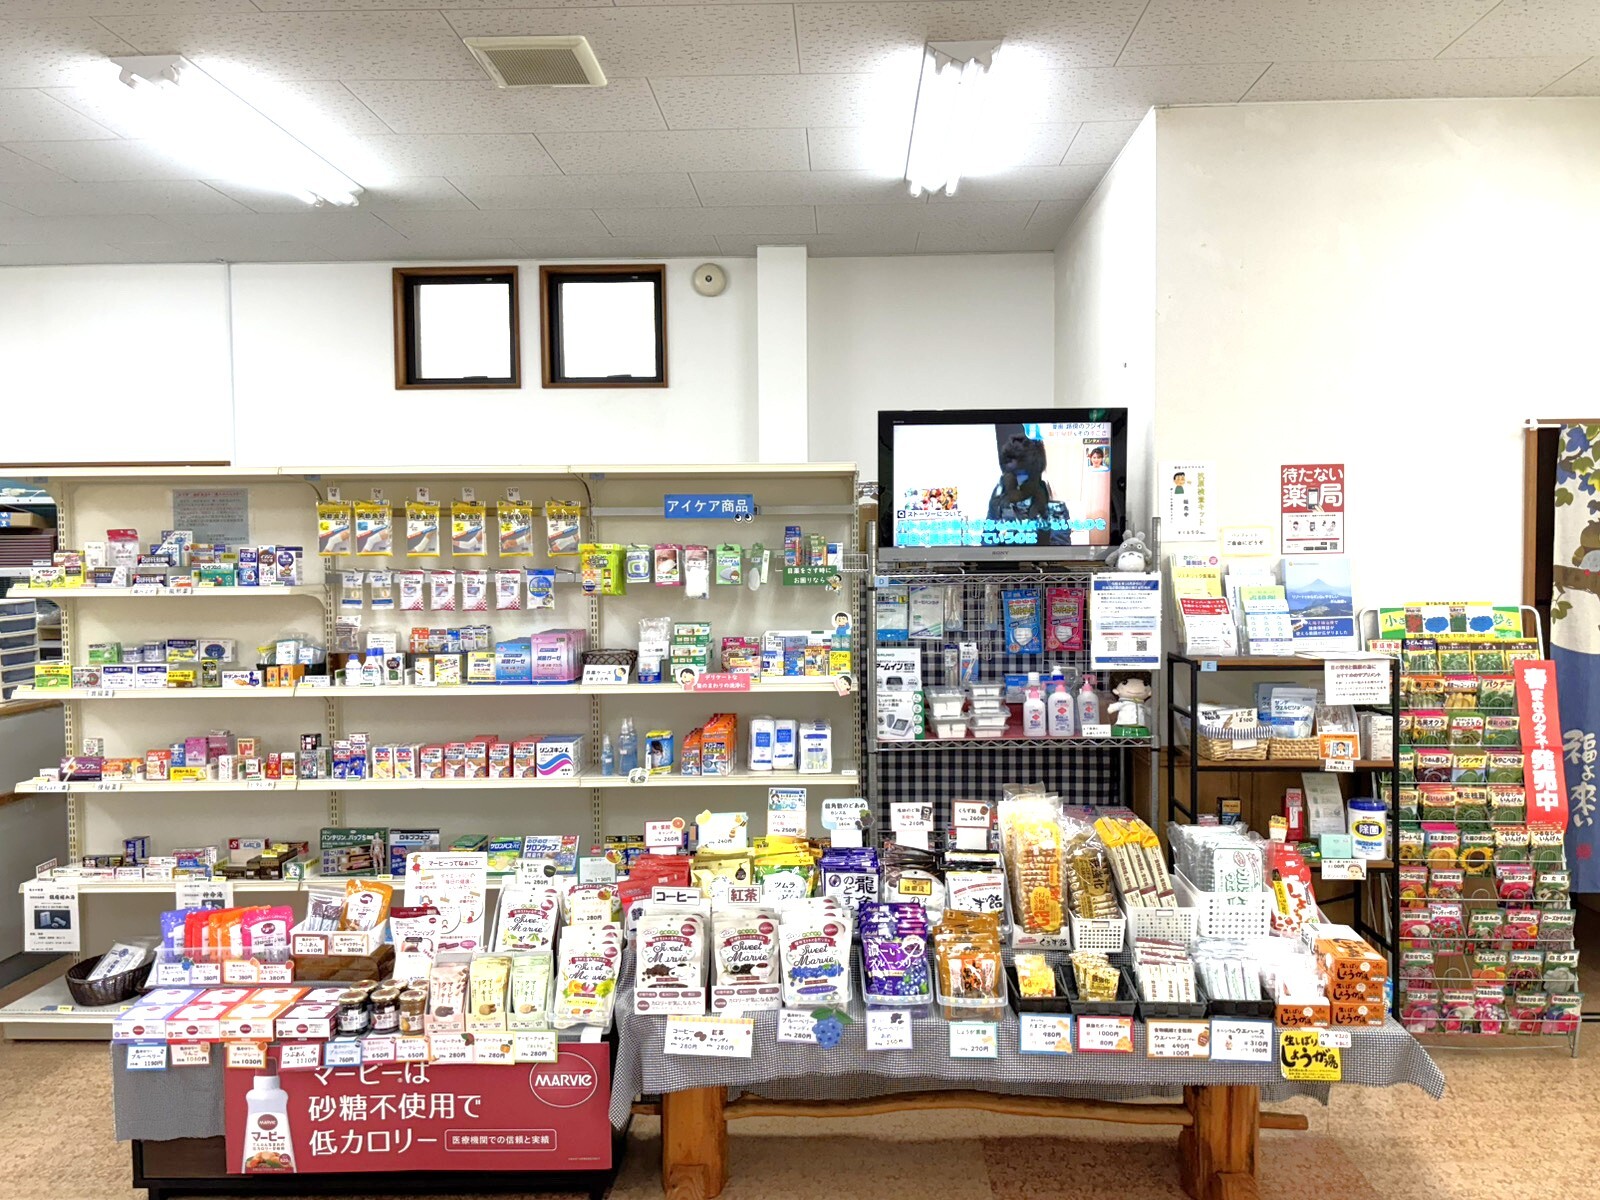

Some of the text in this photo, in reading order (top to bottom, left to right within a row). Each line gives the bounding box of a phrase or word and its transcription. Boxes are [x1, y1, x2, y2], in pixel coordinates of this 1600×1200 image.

[1282, 468, 1343, 483] 待たない
[1282, 483, 1343, 508] 薬局
[667, 500, 749, 513] アイケア商品
[787, 567, 832, 575] 目薬をさす時に
[1563, 729, 1597, 827] 福よ来い
[1359, 824, 1379, 835] 除菌
[656, 891, 698, 902] コーヒー
[730, 888, 758, 902] 紅茶
[731, 942, 763, 952] Sweet
[801, 944, 829, 956] Sweet
[726, 951, 769, 963] Marvie
[793, 956, 835, 967] Marvie
[1340, 962, 1359, 970] 生しぼり
[1337, 968, 1370, 981] しょうが湯
[1333, 988, 1366, 1001] しょうが湯
[1338, 1006, 1358, 1014] 生しぼり
[1280, 1013, 1313, 1026] しょうが湯
[1335, 1012, 1367, 1025] しょうが湯
[793, 1032, 812, 1040] 280円
[1284, 1034, 1318, 1048] 生しぼり
[1281, 1044, 1339, 1069] しょうが湯
[312, 1063, 430, 1087] マービーは
[534, 1073, 593, 1087] MARVIE
[309, 1092, 482, 1122] 砂糖不使用で
[251, 1131, 286, 1142] マービー
[309, 1129, 438, 1156] 低カロリー
[451, 1134, 550, 1146] 医療機関での信頼と実績
